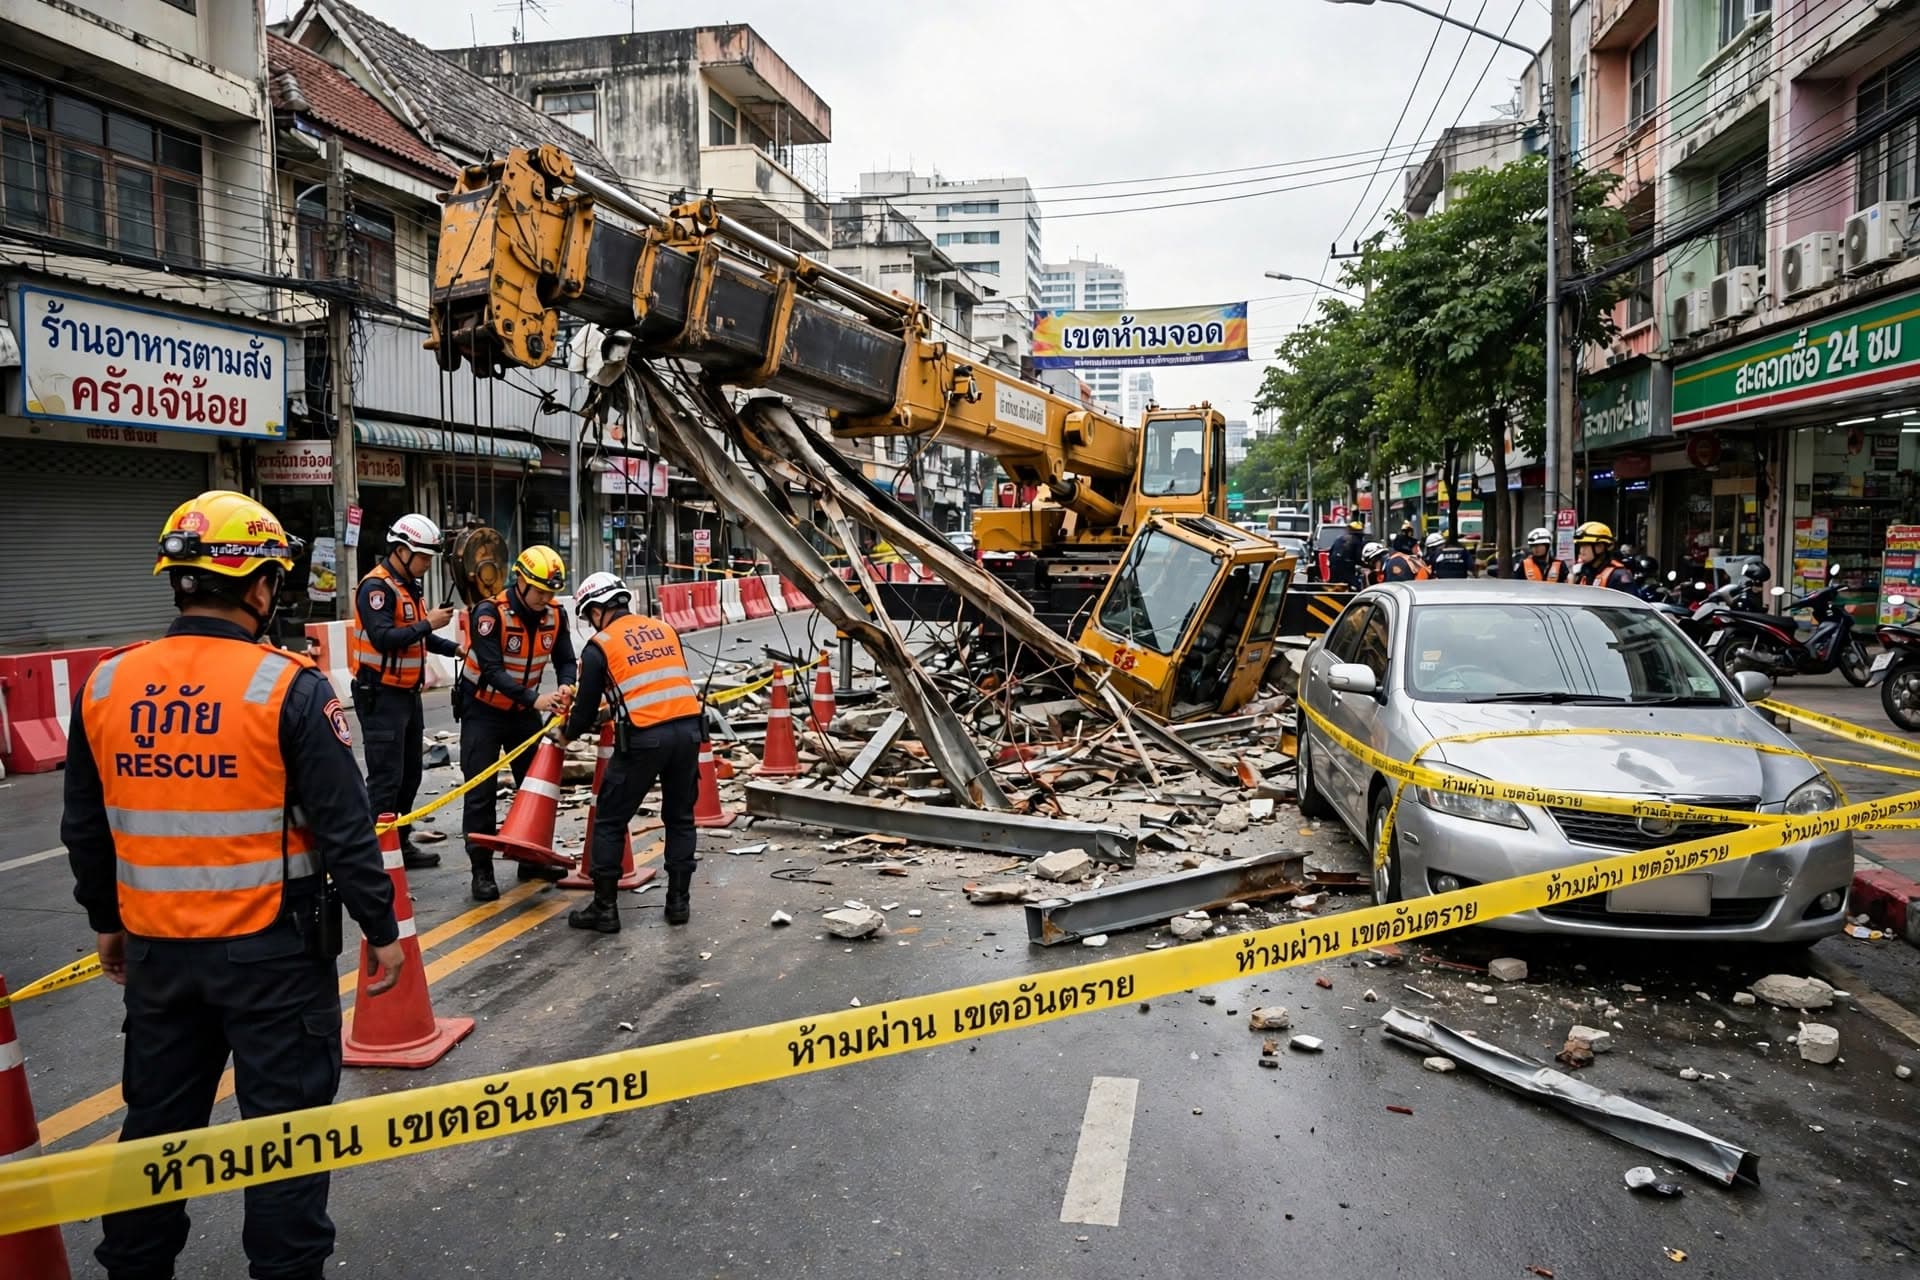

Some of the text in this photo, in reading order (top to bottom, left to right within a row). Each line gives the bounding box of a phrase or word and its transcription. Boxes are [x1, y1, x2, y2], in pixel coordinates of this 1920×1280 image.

[42, 300, 272, 380] ร้านอาหารตามสั่ง
[1064, 315, 1223, 350] เขตห้ามจอด
[1827, 325, 1860, 373] 24
[1867, 323, 1902, 363] ชม
[72, 365, 247, 427] ครัวเจ๊น้อย
[623, 624, 665, 651] กู้ภัย
[627, 645, 677, 666] RESCUE
[130, 684, 222, 748] กู้ภัย
[115, 754, 238, 778] RESCUE
[1442, 775, 1495, 796] ห้ามผ่าน
[143, 1121, 363, 1195] ห้ามผ่าน
[388, 1070, 648, 1148] เขตอันตราย
[787, 1011, 937, 1067] ห้ามผ่าน
[954, 982, 1135, 1033] เขตอันตราย
[1236, 928, 1340, 972] ห้ามผ่าน
[1351, 901, 1478, 948] เขตอันตราย
[1546, 866, 1624, 902] ห้ามผ่าน
[1631, 845, 1730, 881] เขตอันตราย
[1781, 816, 1839, 845] ห้ามผ่าน
